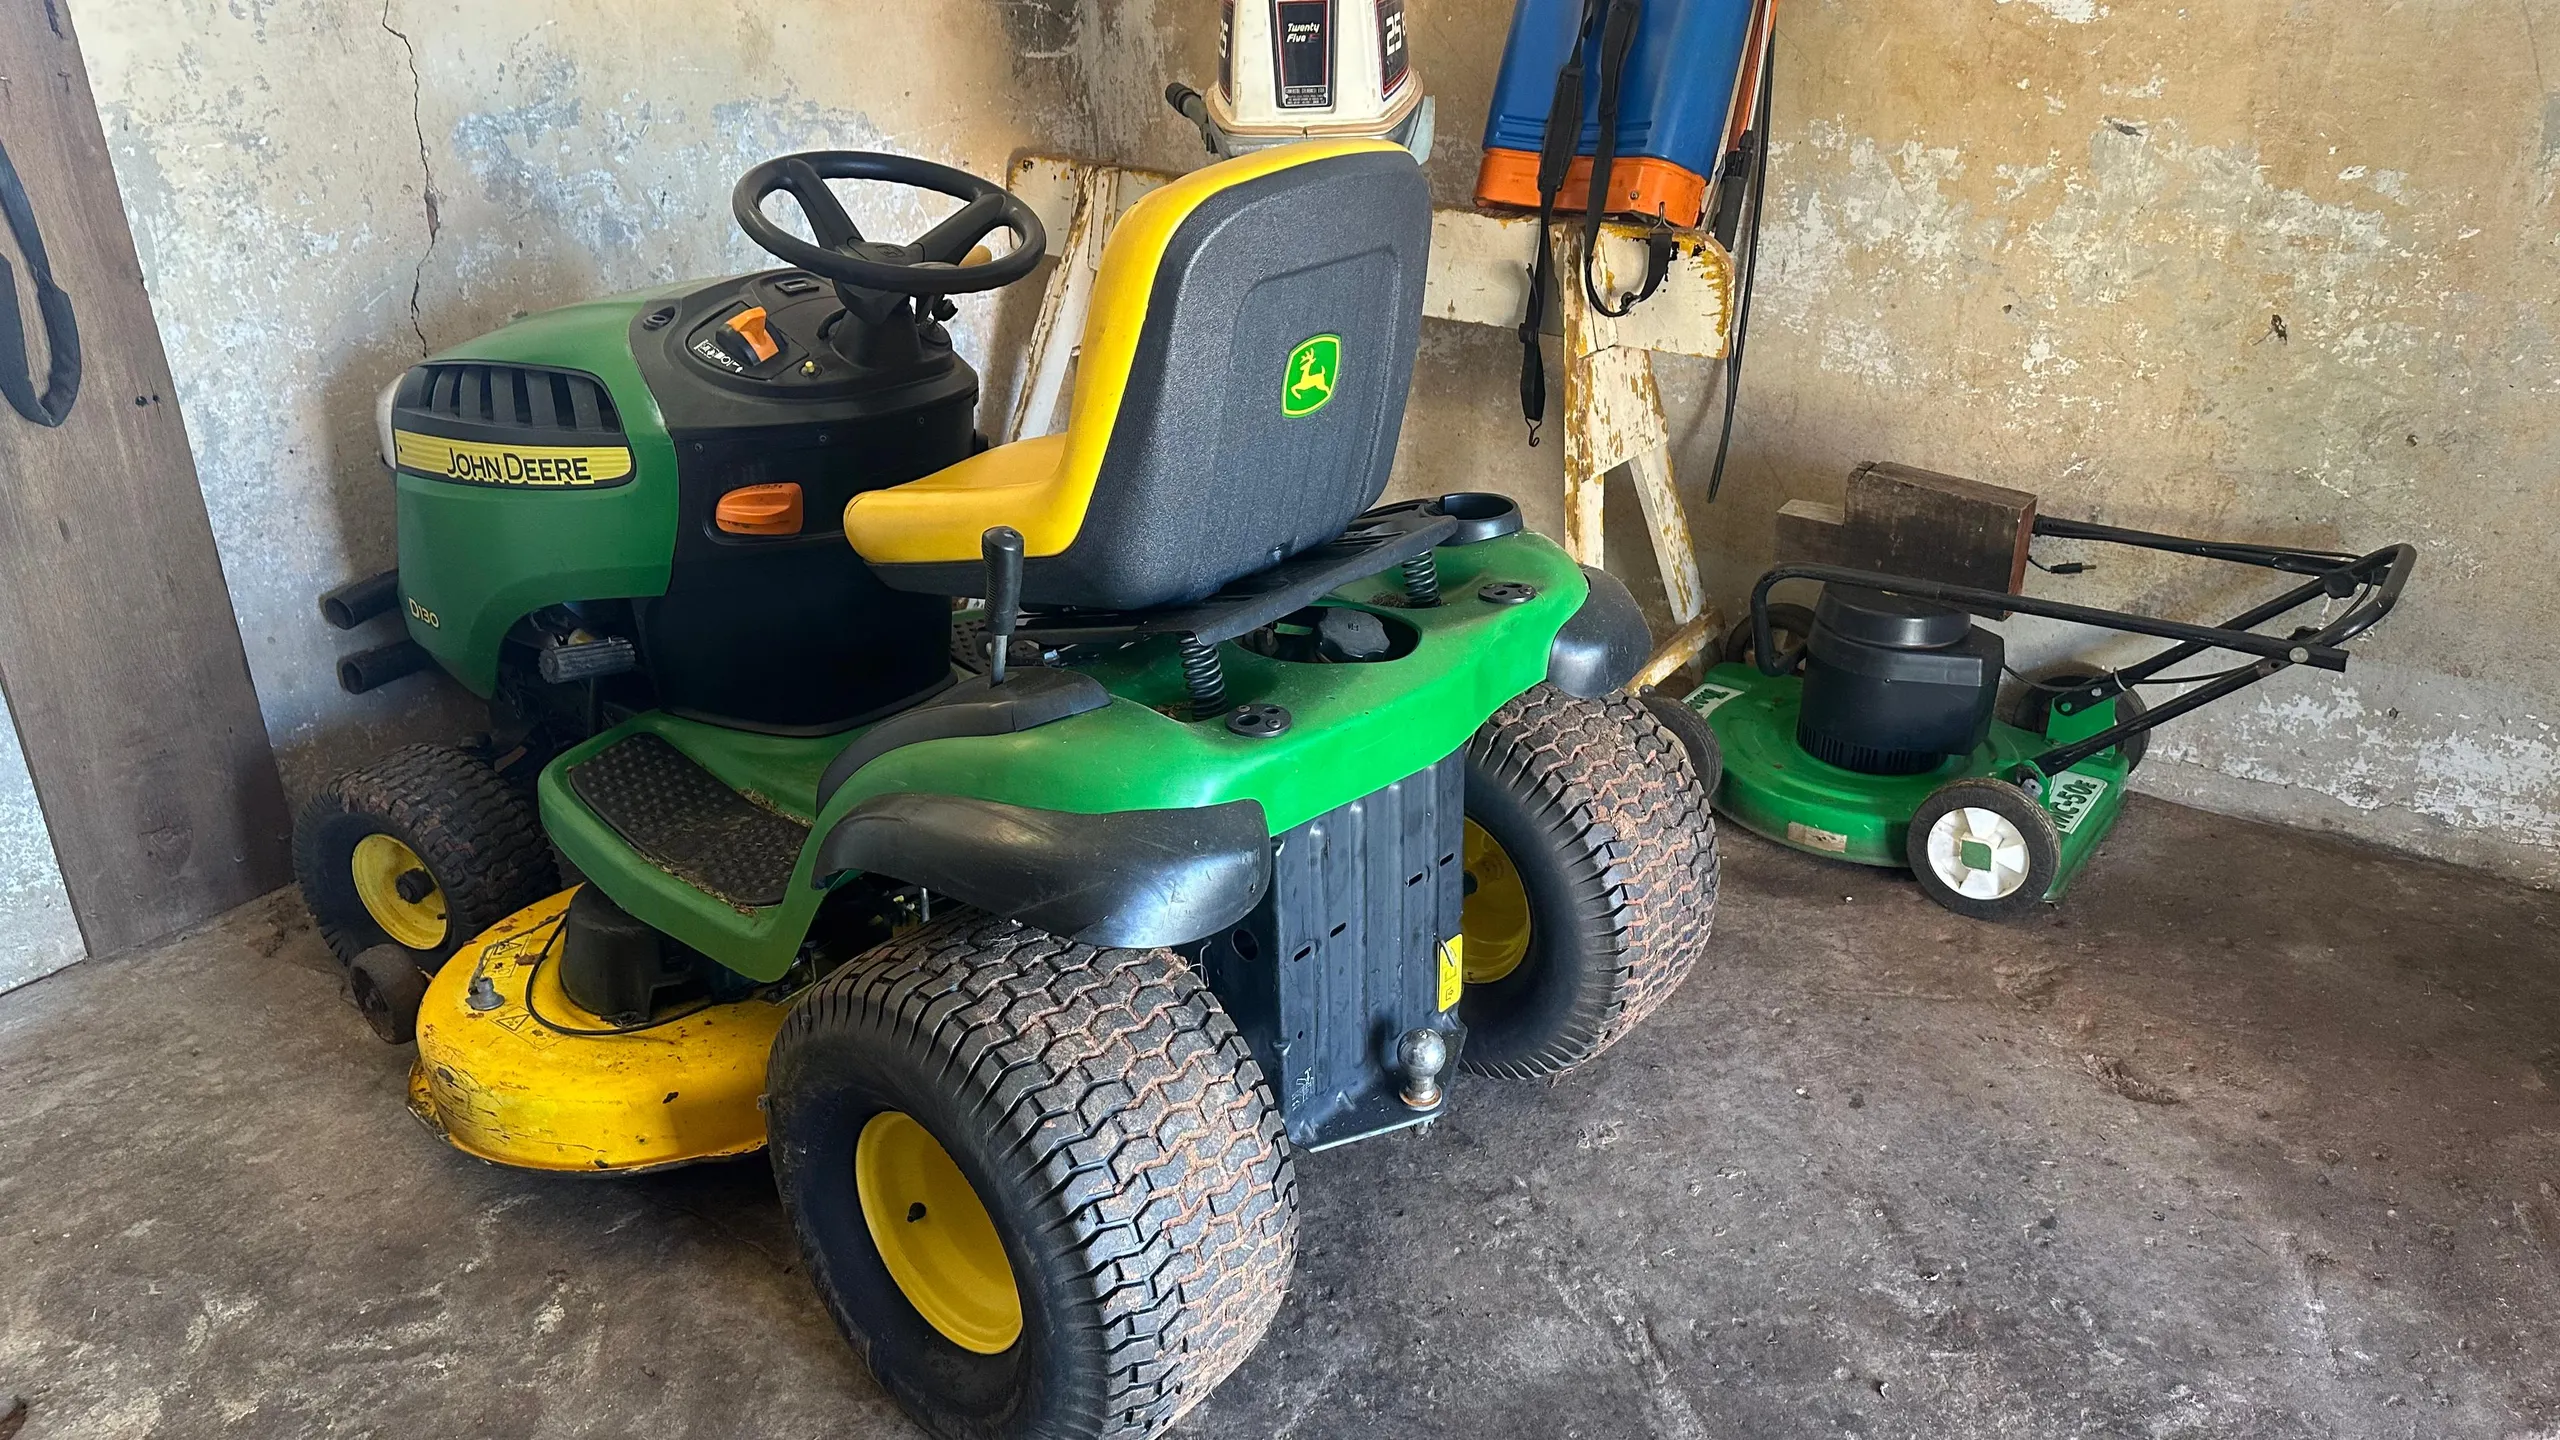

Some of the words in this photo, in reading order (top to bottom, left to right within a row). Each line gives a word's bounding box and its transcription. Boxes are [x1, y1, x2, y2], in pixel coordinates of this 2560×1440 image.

[1286, 33, 1306, 43] Five
[1287, 21, 1320, 33] Twenty
[1385, 11, 1401, 57] 25
[446, 447, 503, 480] JOHN
[502, 452, 592, 482] DEERE
[408, 597, 439, 628] D130
